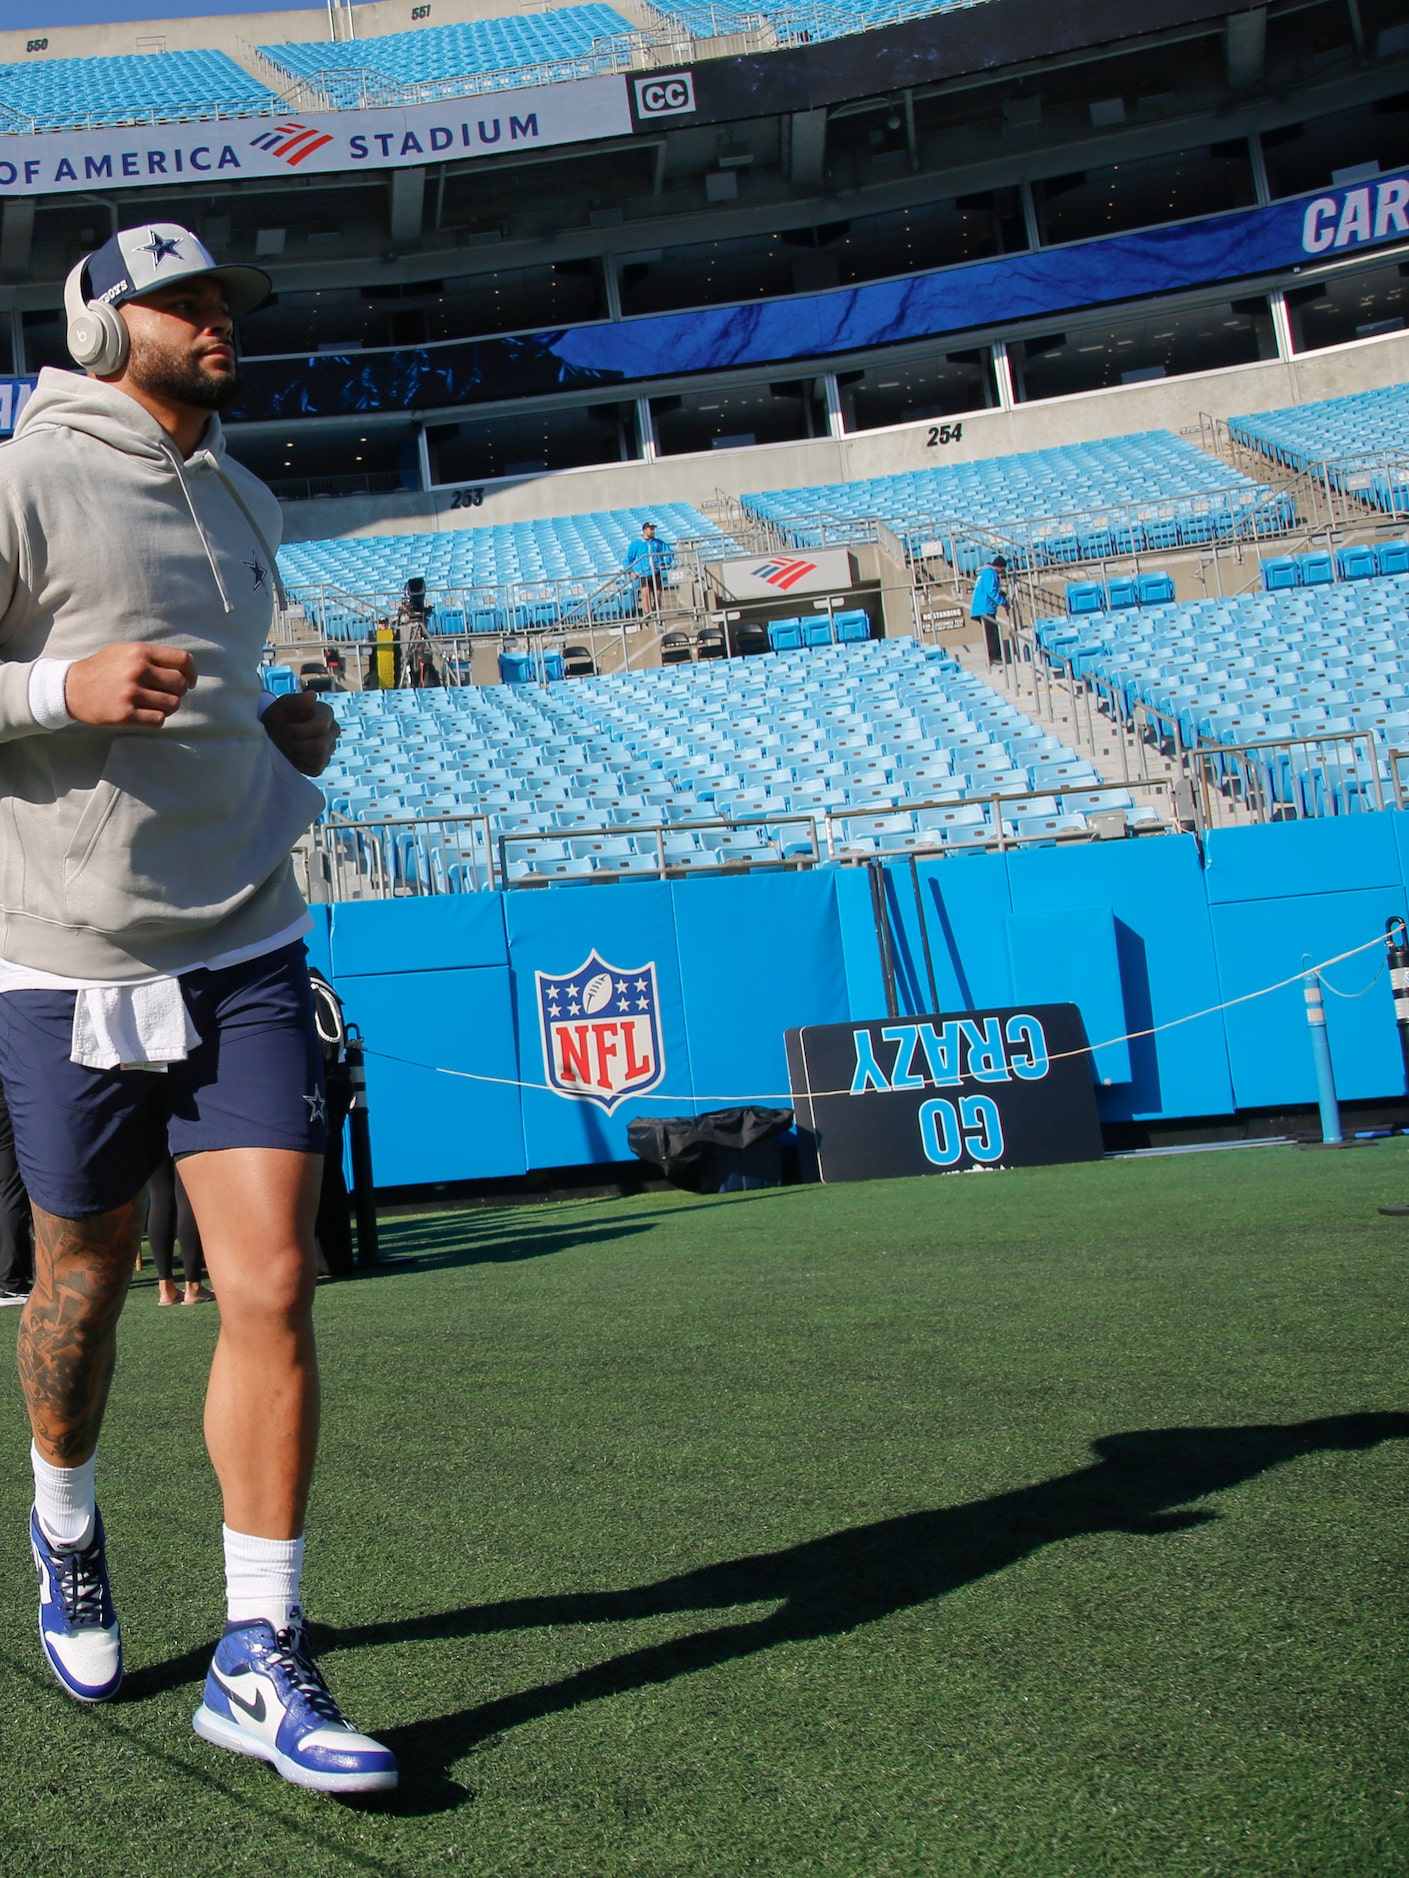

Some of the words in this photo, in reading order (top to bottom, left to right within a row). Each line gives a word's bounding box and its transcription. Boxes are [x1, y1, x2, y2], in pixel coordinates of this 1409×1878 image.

[411, 4, 431, 20] 551
[26, 38, 49, 53] 550
[645, 83, 685, 110] CC
[54, 144, 242, 183] AMERICA
[350, 112, 540, 160] STADIUM
[1301, 179, 1409, 254] CAR
[927, 422, 962, 447] 254
[450, 487, 484, 509] 253
[555, 1021, 651, 1091] NFL
[849, 1013, 1050, 1096] CRAZY
[918, 1094, 1005, 1166] GO
